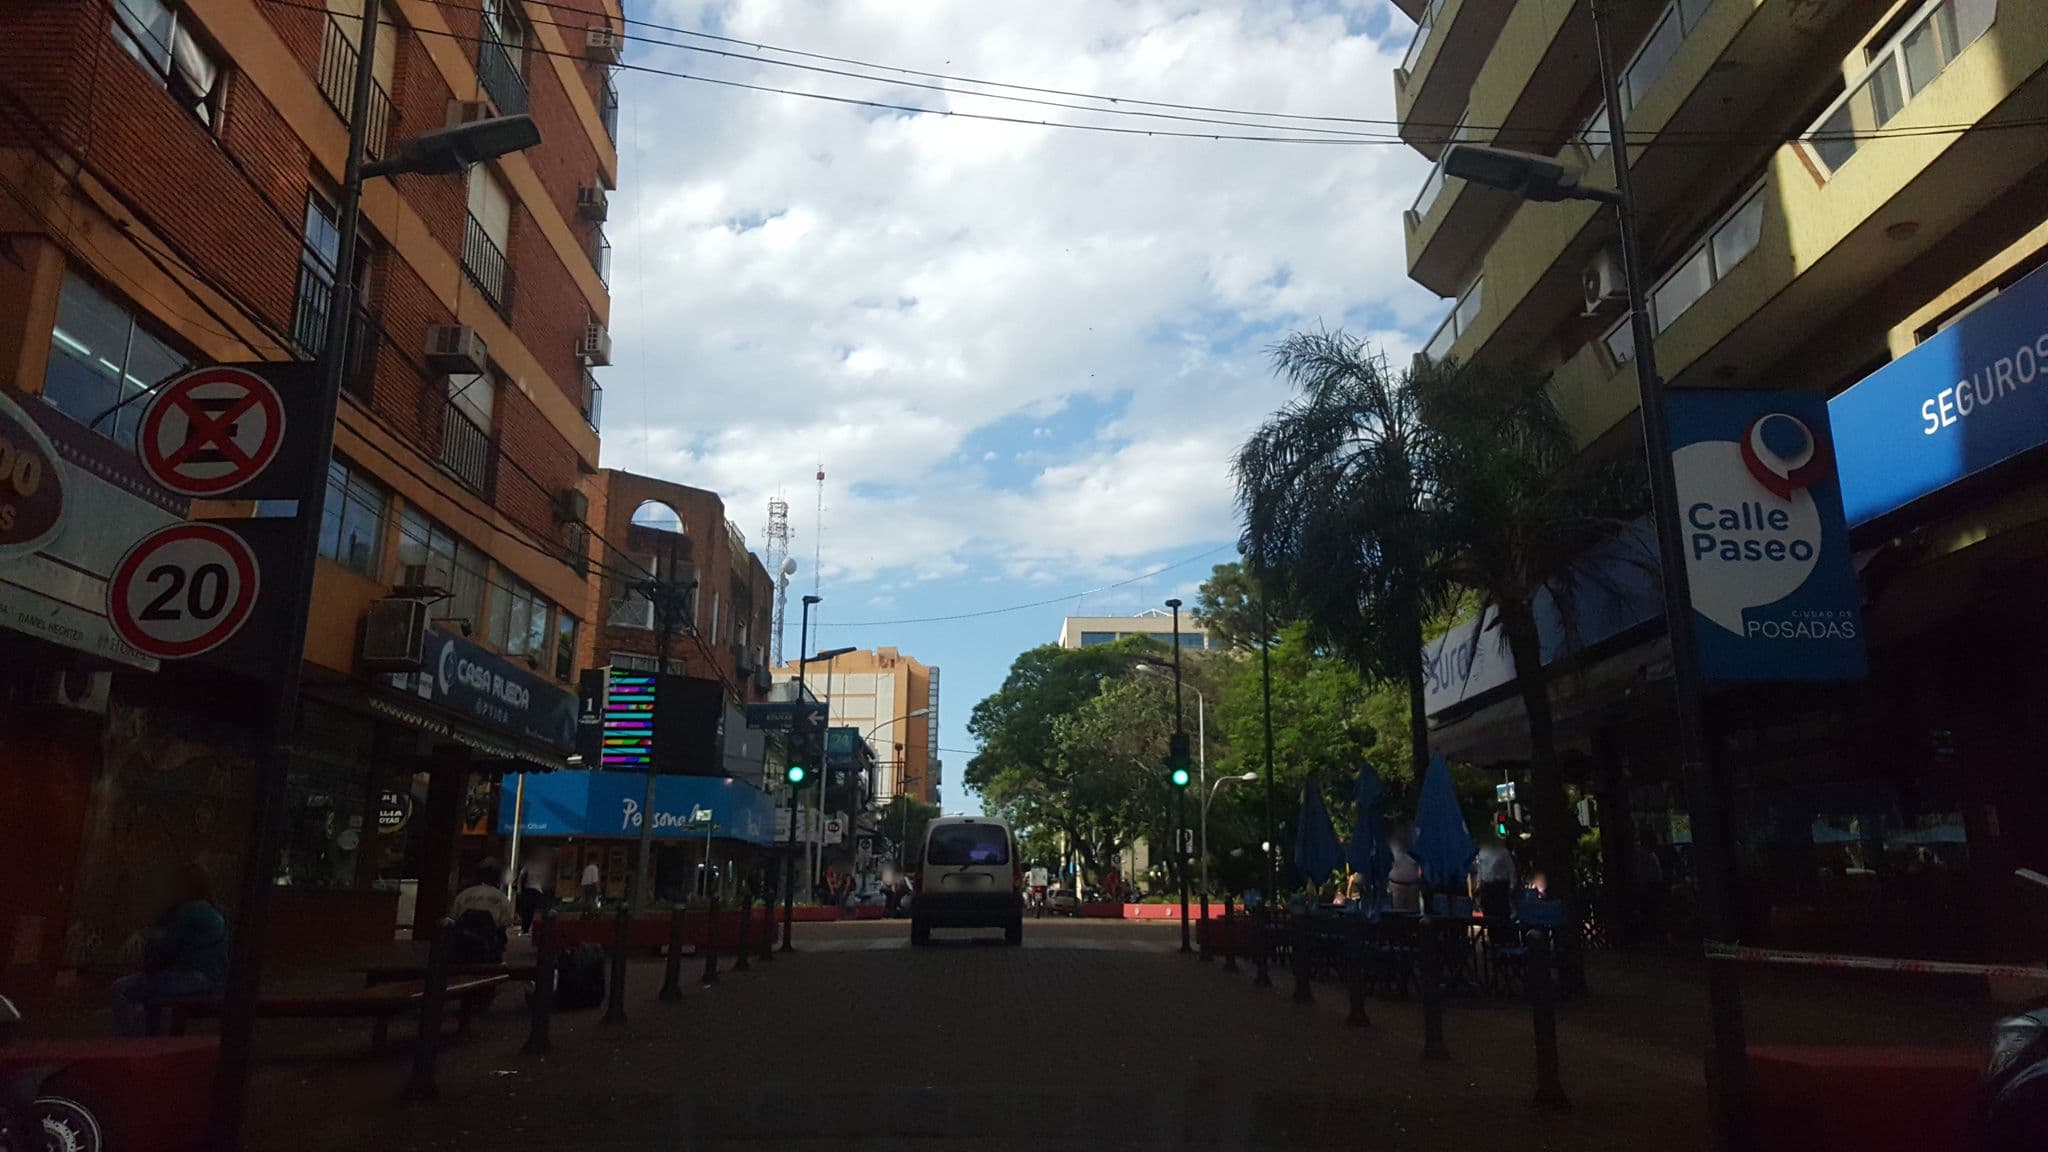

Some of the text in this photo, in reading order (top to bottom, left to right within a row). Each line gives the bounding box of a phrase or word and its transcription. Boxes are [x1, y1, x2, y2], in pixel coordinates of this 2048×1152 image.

[1921, 333, 2048, 435] SEGUROS
[1689, 502, 1789, 531] Calle
[1692, 533, 1813, 561] Paseo
[138, 563, 229, 620] 20
[1747, 620, 1857, 639] POSADAS
[457, 658, 530, 711] CASA RUEDA
